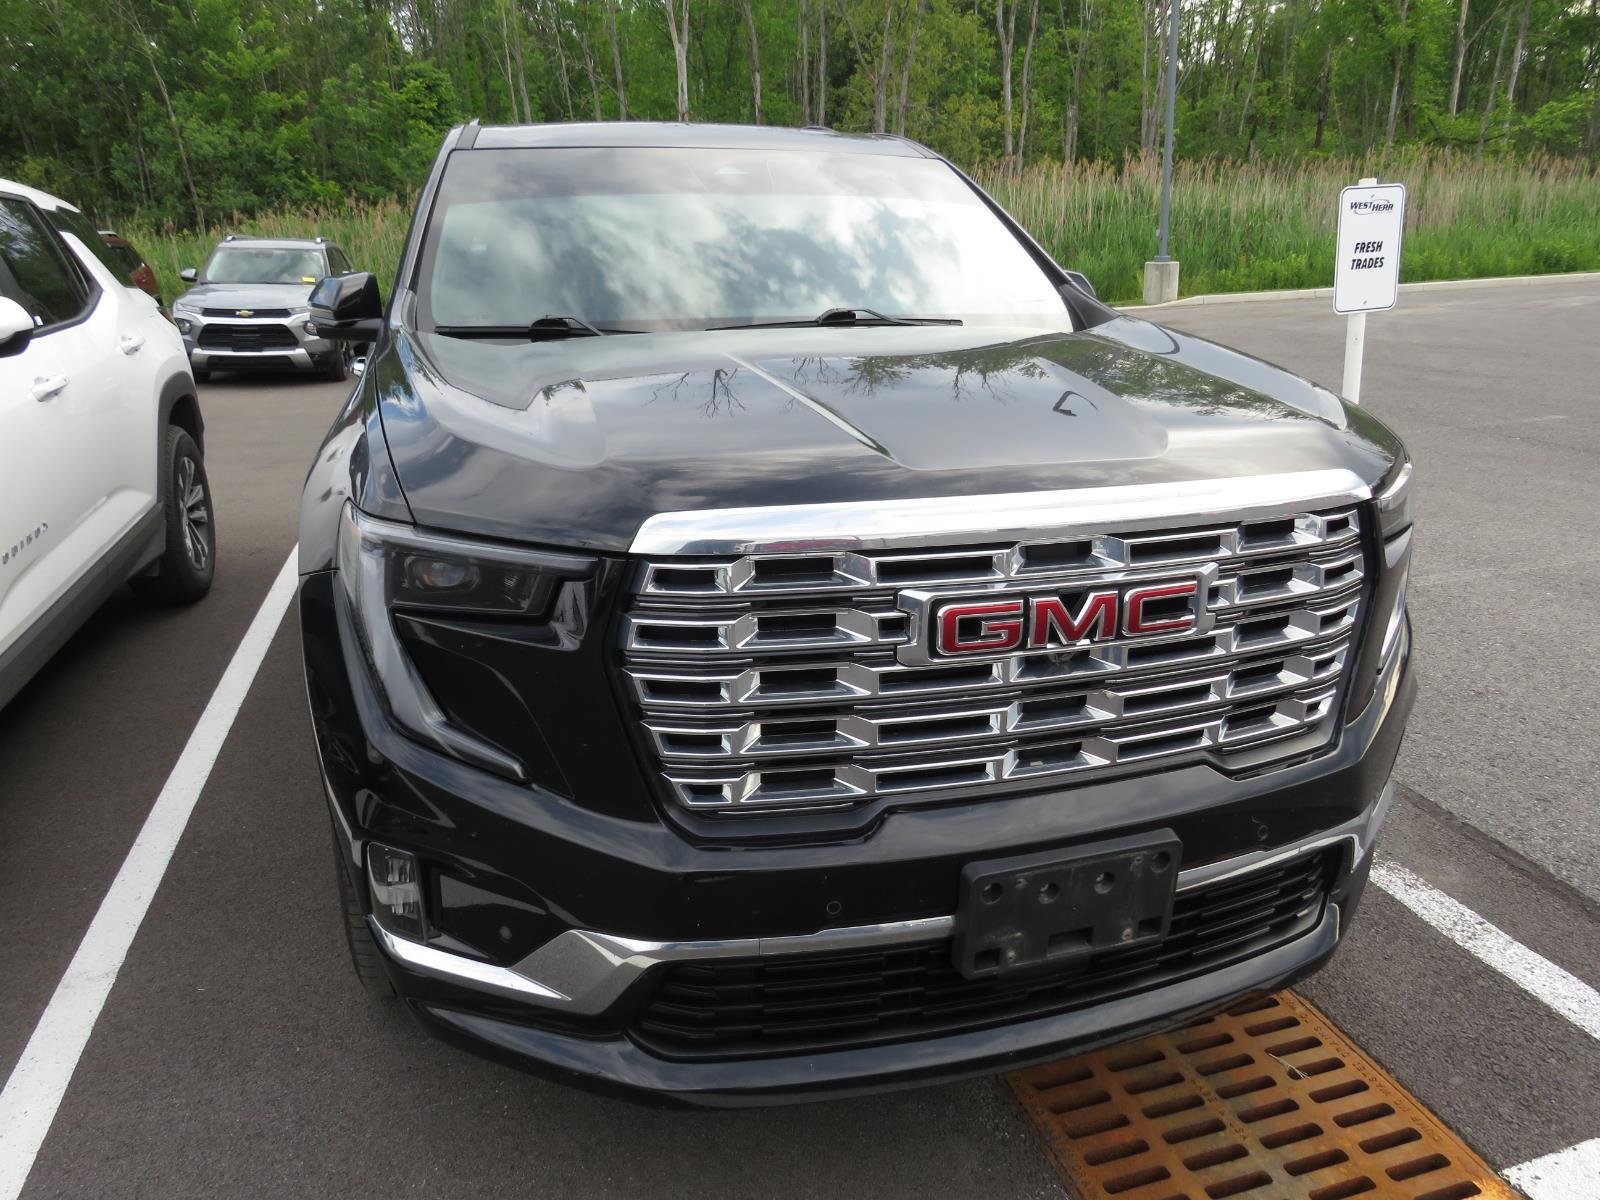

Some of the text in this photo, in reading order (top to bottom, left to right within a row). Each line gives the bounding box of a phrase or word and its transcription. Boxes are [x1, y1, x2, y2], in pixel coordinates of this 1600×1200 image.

[1350, 201, 1394, 212] WEST HERR
[1354, 241, 1383, 254] FRESH
[1351, 257, 1385, 270] TRADES
[937, 581, 1197, 656] GMC
